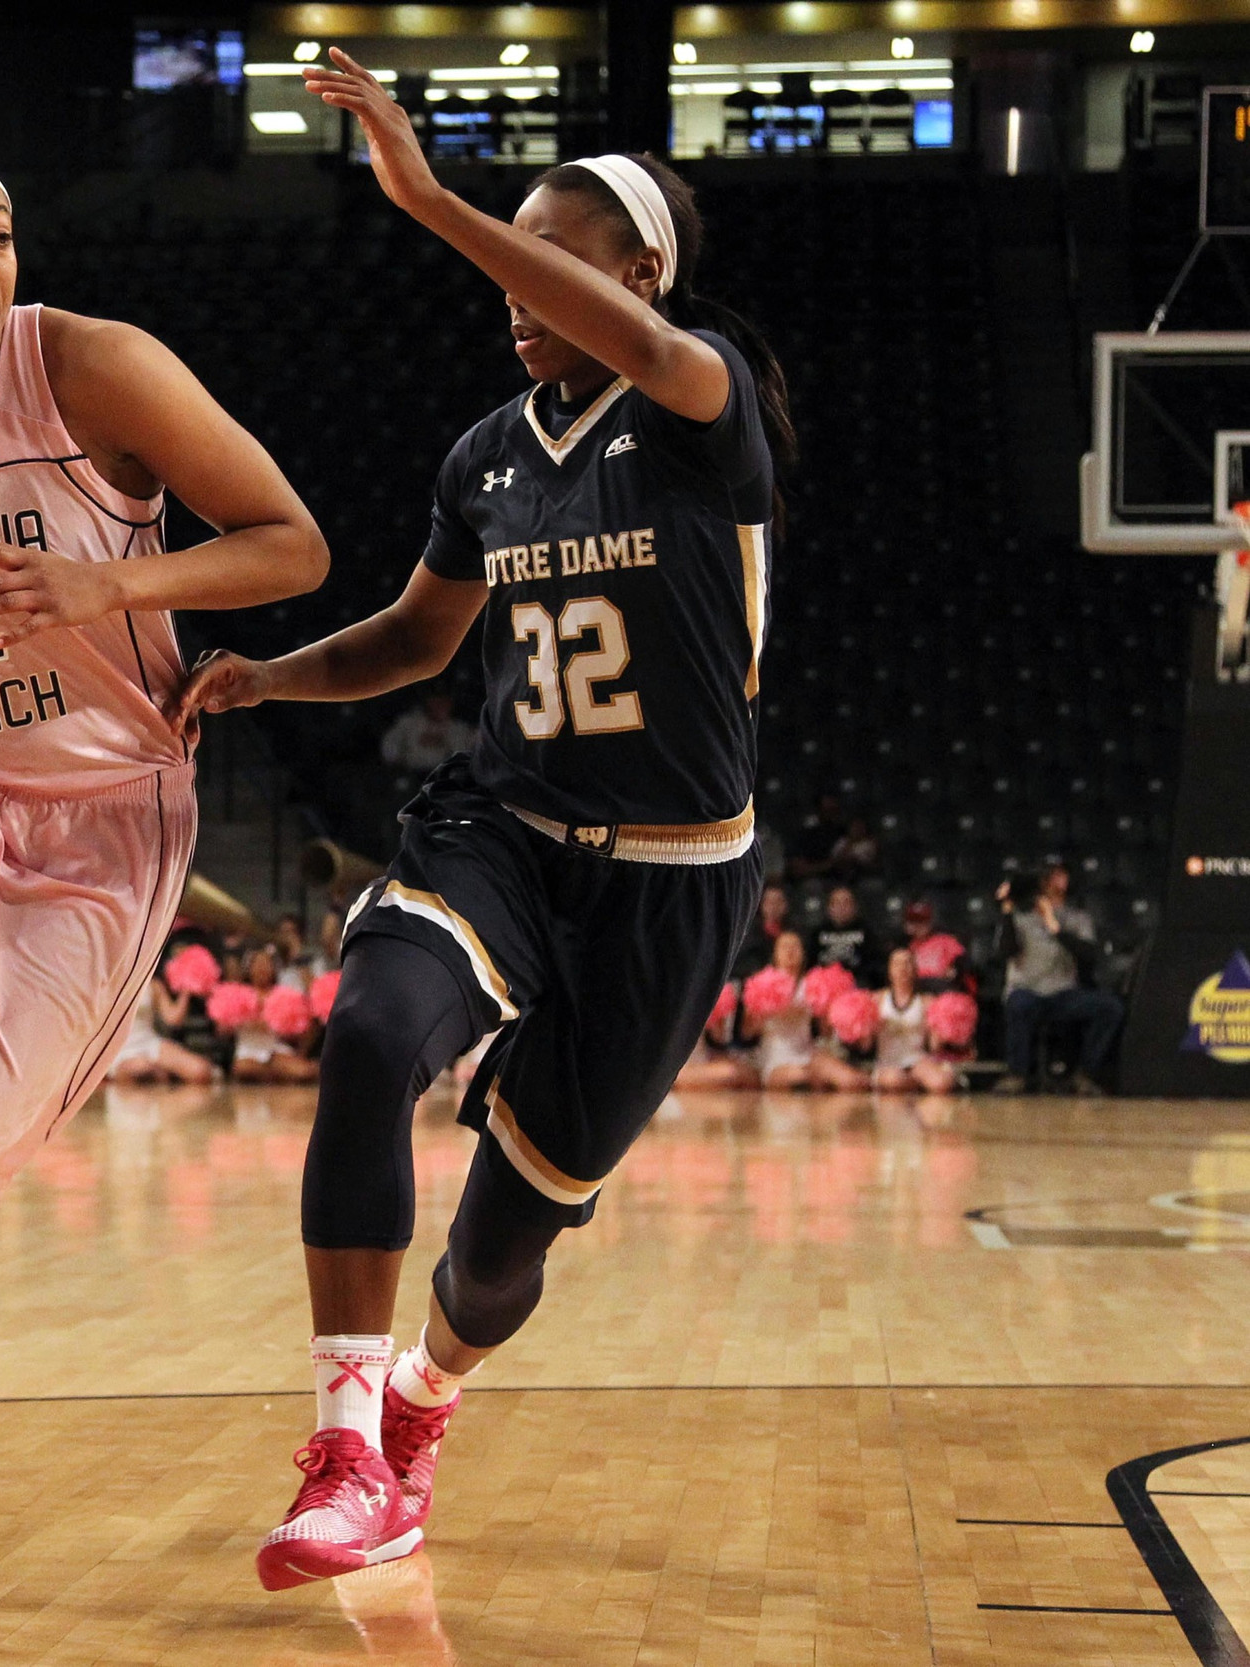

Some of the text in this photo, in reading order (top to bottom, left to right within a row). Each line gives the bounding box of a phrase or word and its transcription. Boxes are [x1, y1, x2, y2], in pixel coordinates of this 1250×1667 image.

[484, 528, 657, 588] OTRE DAME
[511, 595, 645, 741] 32
[345, 1352, 390, 1362] FIGH
